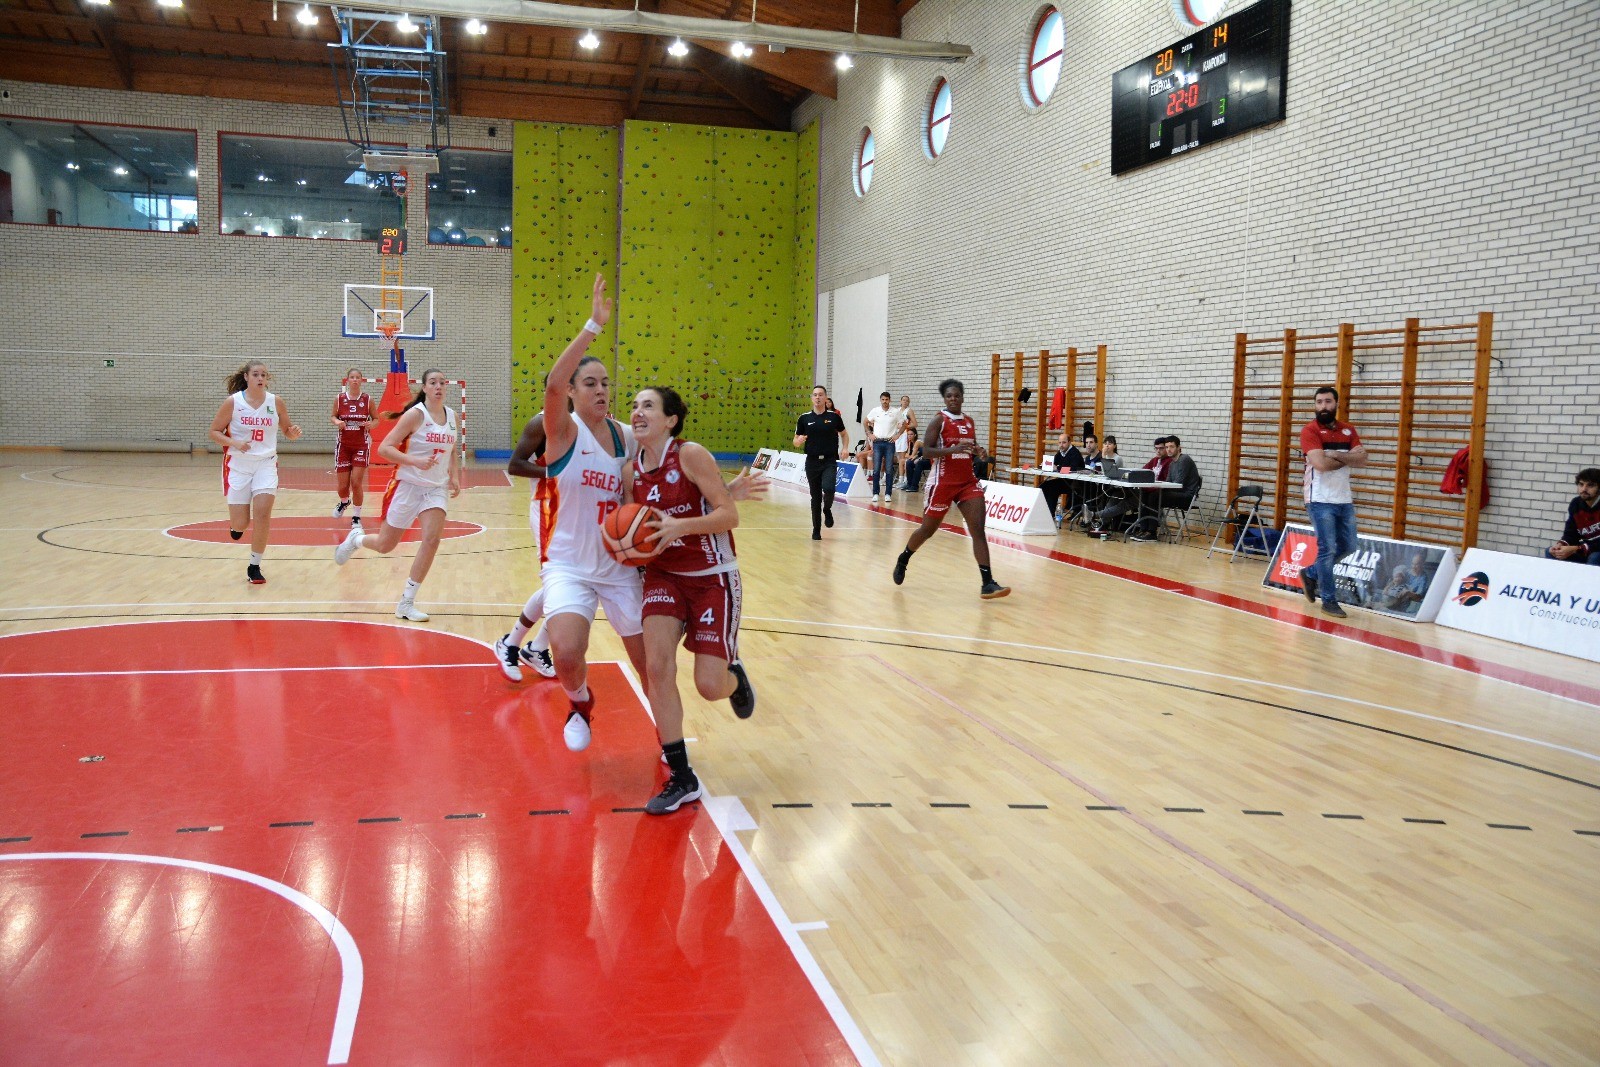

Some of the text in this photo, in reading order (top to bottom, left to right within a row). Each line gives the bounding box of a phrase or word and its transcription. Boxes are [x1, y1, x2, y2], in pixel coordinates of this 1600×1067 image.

[1213, 23, 1228, 47] 14
[1155, 49, 1173, 75] 20
[1219, 97, 1226, 115] 3
[349, 405, 357, 413] 3
[241, 417, 259, 426] SEGLE
[956, 425, 968, 434] 15
[251, 429, 264, 442] 18
[426, 432, 445, 443] SEGLE
[581, 469, 615, 492] SEGLE
[646, 484, 661, 502] 4
[1499, 584, 1600, 614] ALTUNA Y U
[699, 607, 715, 625] 4
[1529, 605, 1600, 629] Construccio
